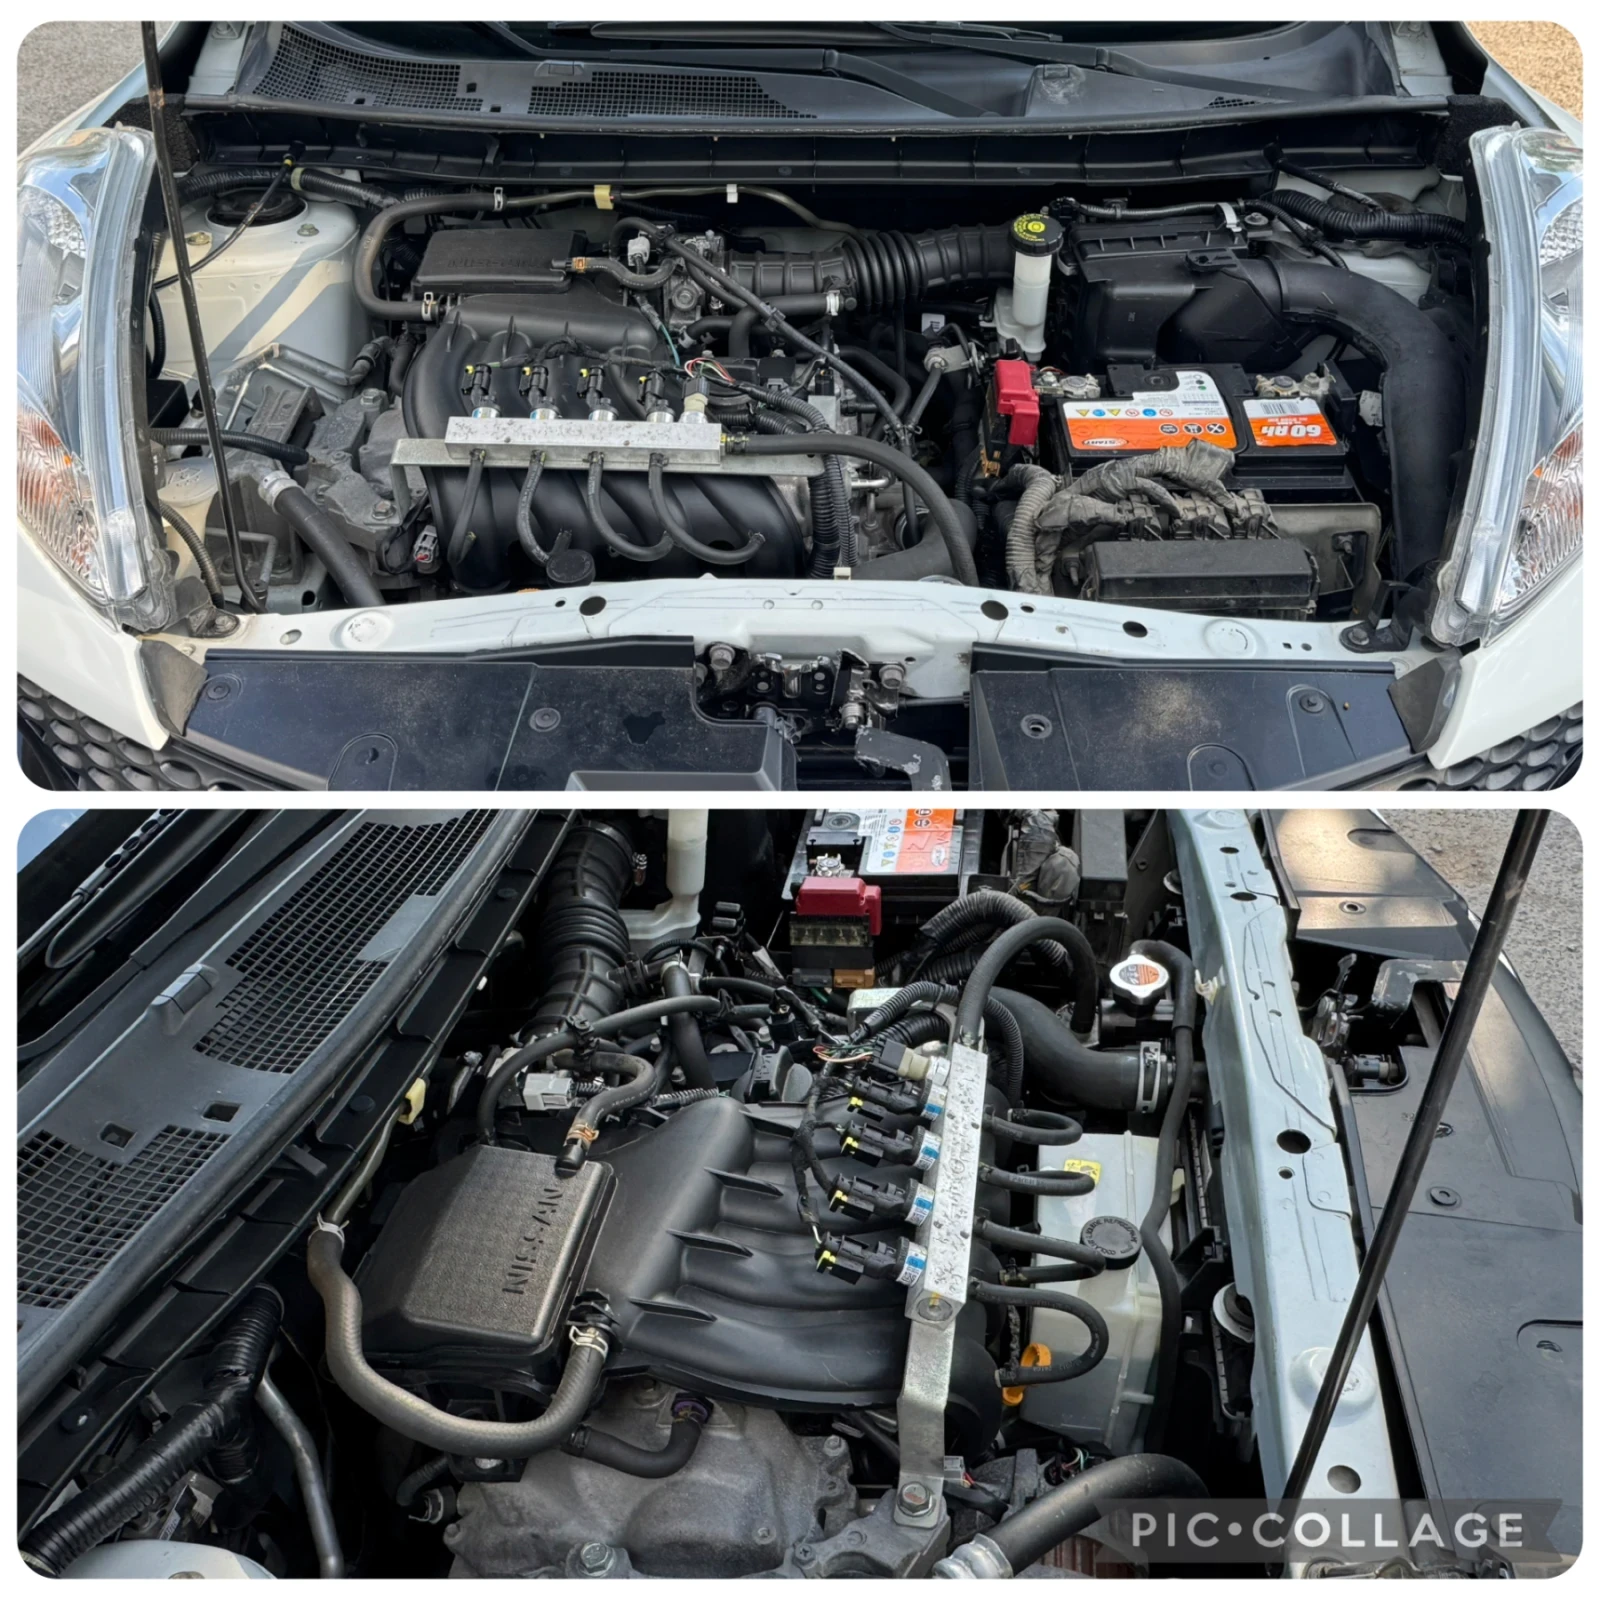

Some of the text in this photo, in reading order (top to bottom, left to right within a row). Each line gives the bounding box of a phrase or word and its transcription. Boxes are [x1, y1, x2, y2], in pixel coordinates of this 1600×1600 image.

[1261, 424, 1321, 438] 60 Ah
[501, 1187, 563, 1295] NISSAN
